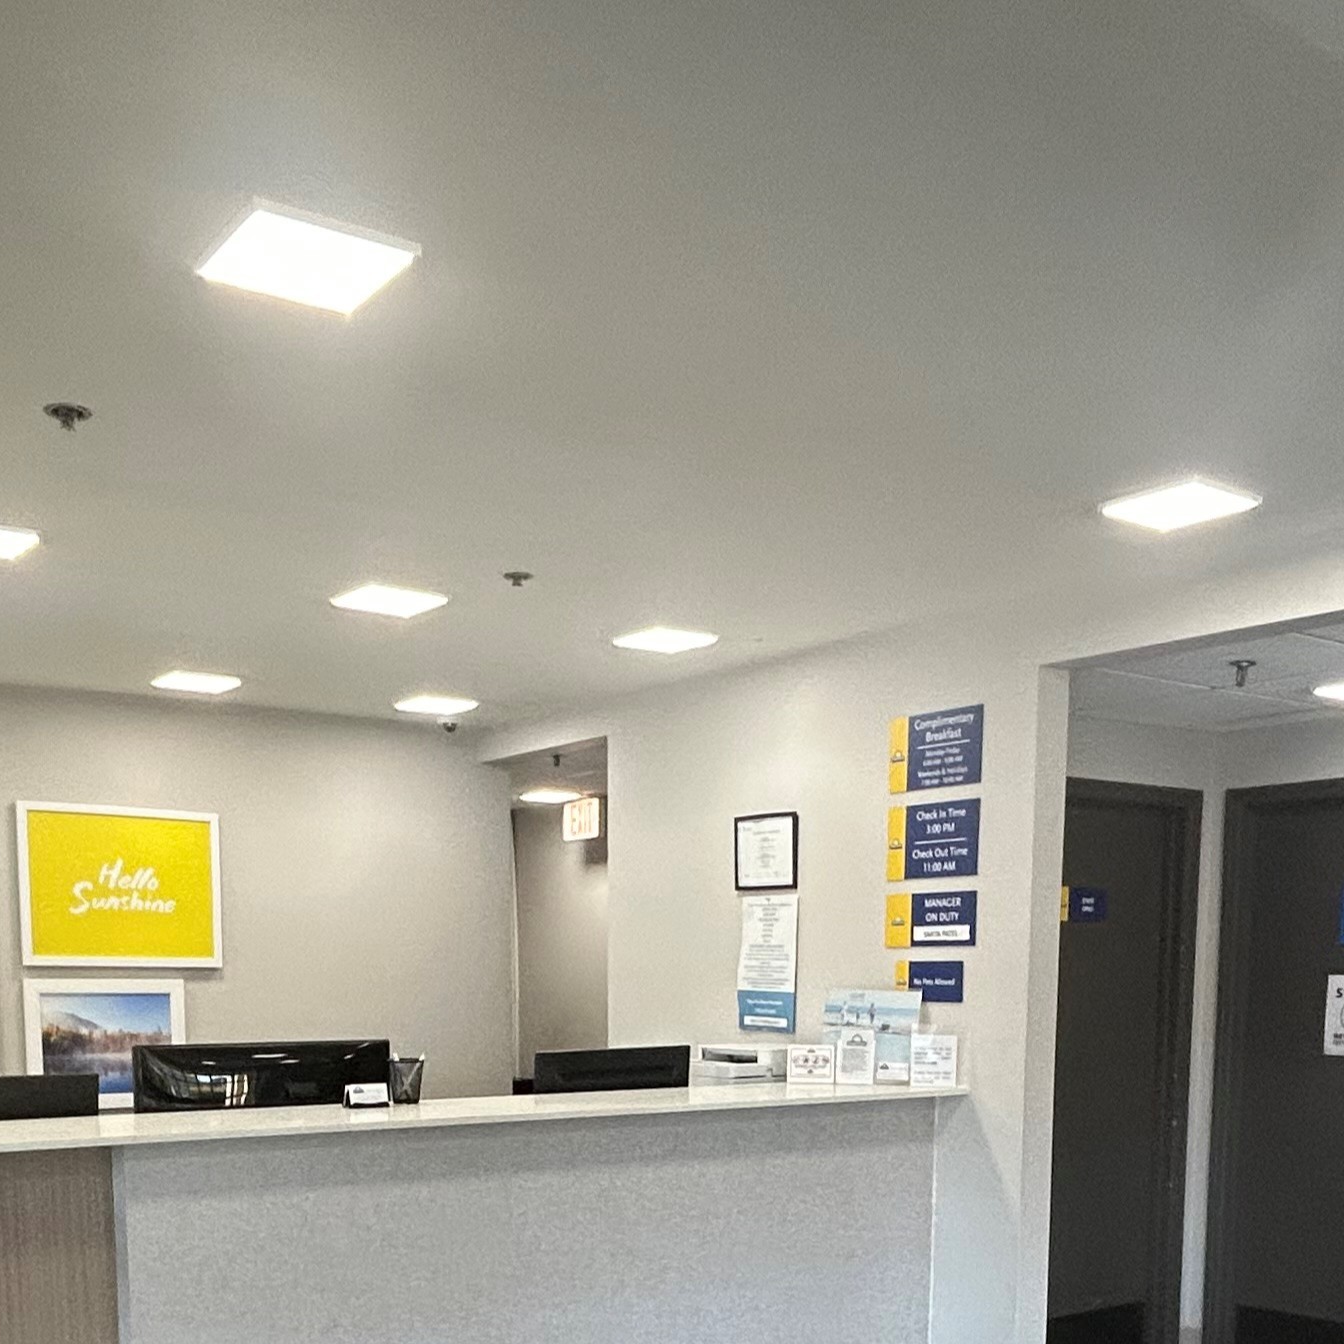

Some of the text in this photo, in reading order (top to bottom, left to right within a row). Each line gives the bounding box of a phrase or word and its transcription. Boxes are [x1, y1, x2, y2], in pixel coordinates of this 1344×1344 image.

[914, 714, 974, 731] Complimentary
[925, 727, 962, 742] Breakfast
[570, 801, 594, 836] EXIT
[916, 807, 967, 821] Check In Time
[926, 822, 955, 834] 3:00 PM
[912, 846, 968, 859] Check Out Time
[923, 861, 956, 872] 11:00 AM
[98, 858, 159, 891] Hello
[69, 880, 176, 915] Sunshine
[924, 897, 962, 908] MANAGER
[925, 911, 959, 922] ON DUTY
